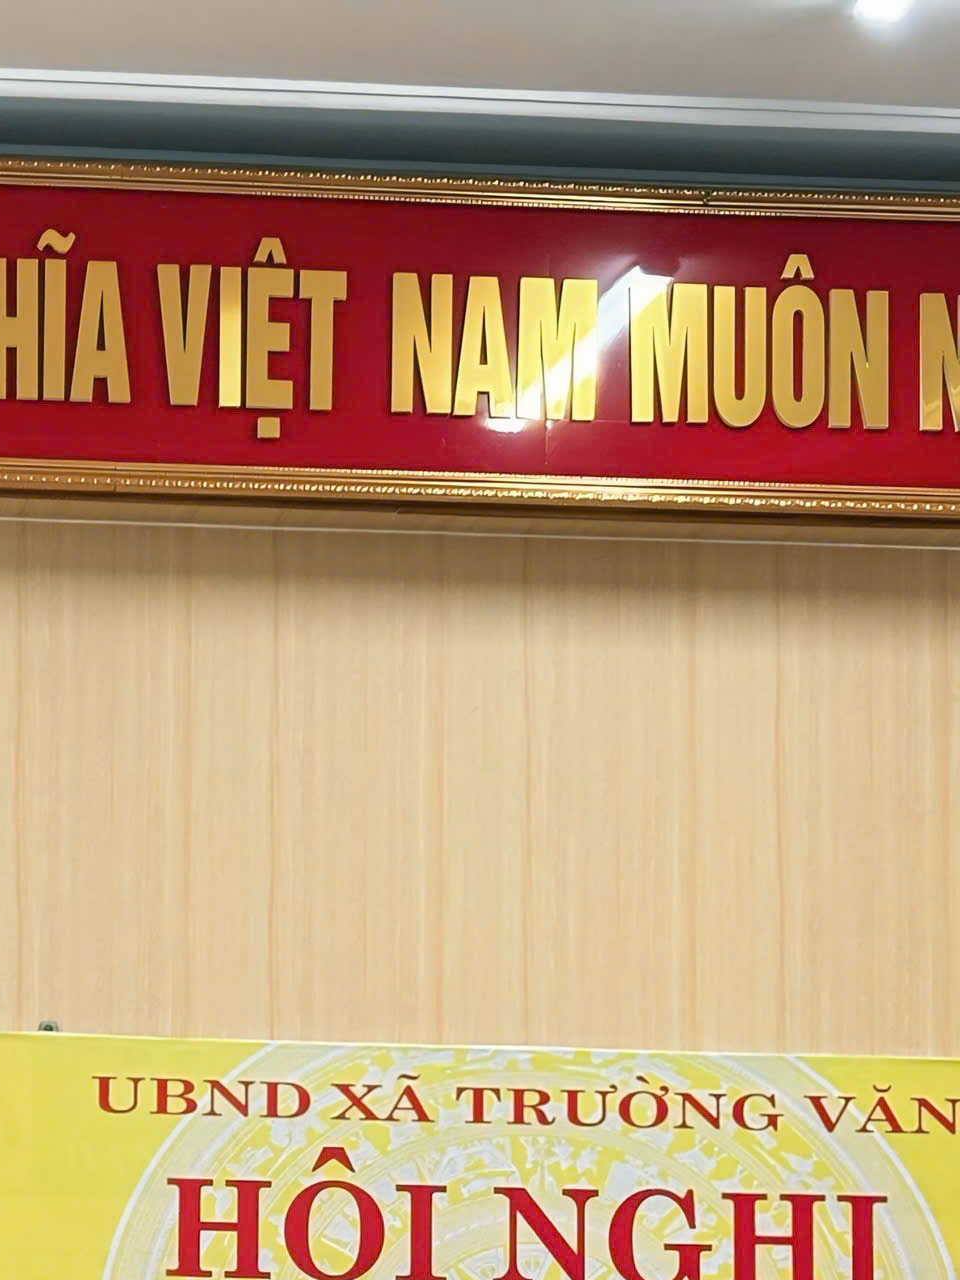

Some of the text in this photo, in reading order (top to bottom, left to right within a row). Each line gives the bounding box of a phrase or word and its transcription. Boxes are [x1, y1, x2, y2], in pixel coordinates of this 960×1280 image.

[156, 237, 347, 439] VIỆT
[390, 271, 598, 422] NAM
[627, 253, 889, 430] MUÔN
[92, 1074, 960, 1135] UBND XÃ TRƯỜNG VĂN
